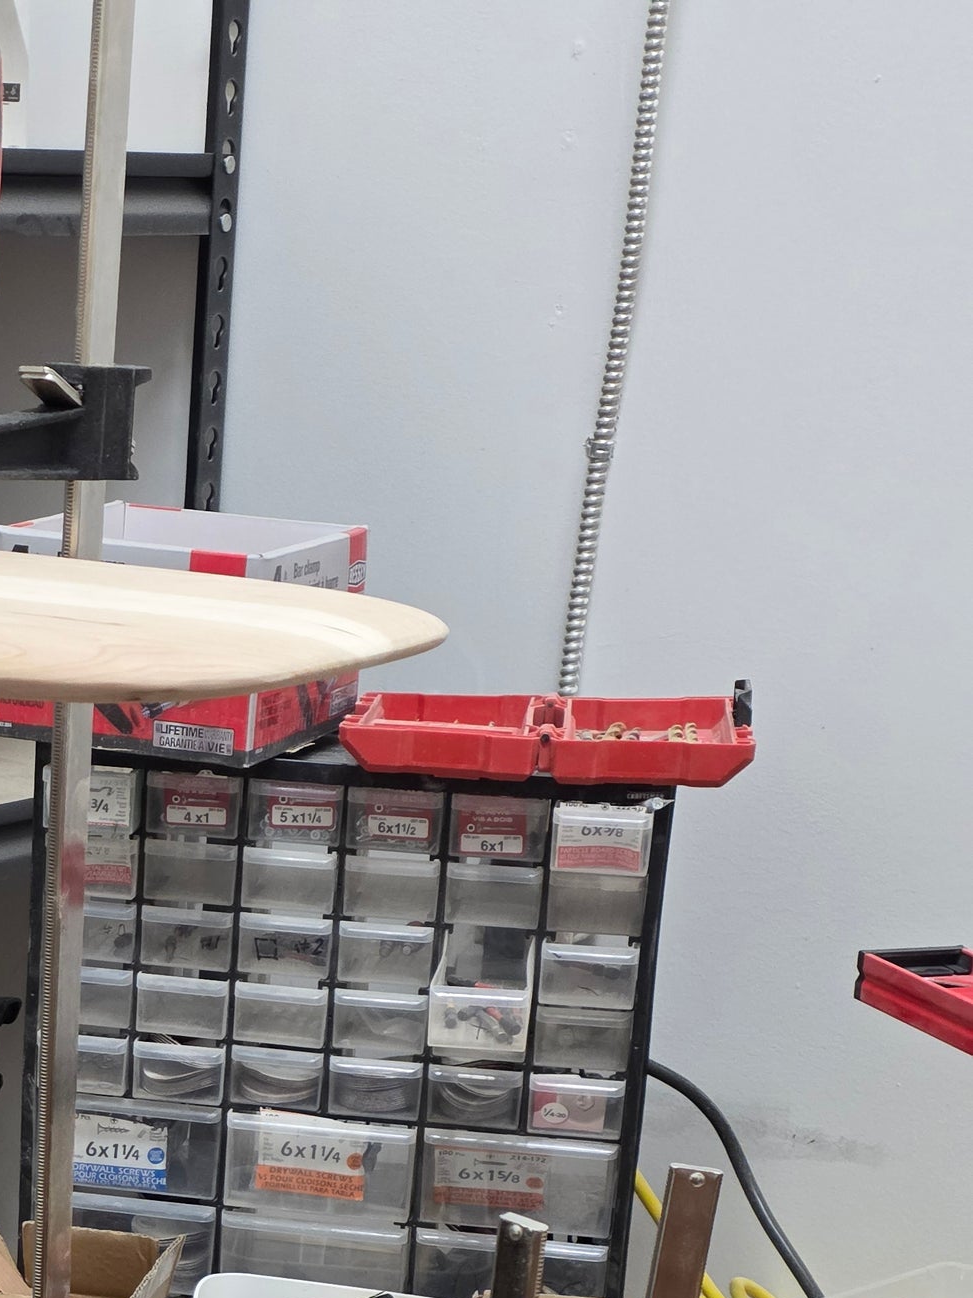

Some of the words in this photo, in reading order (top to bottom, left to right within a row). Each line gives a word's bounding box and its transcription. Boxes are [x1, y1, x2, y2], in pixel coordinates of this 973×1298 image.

[160, 722, 204, 738] LIFETIME
[159, 736, 197, 750] GARANTIE
[207, 741, 226, 754] VIE
[480, 840, 504, 852] 6x1
[74, 1163, 116, 1174] DRYWALL
[119, 1167, 156, 1178] SCREWS
[74, 1170, 97, 1180] POUR
[98, 1172, 139, 1184] CLOISONS
[269, 1166, 313, 1178] DRYWALL
[316, 1172, 353, 1184] SCREWS
[270, 1175, 293, 1183] POUR
[295, 1177, 337, 1189] CLOISONS
[309, 1186, 328, 1194] PARA
